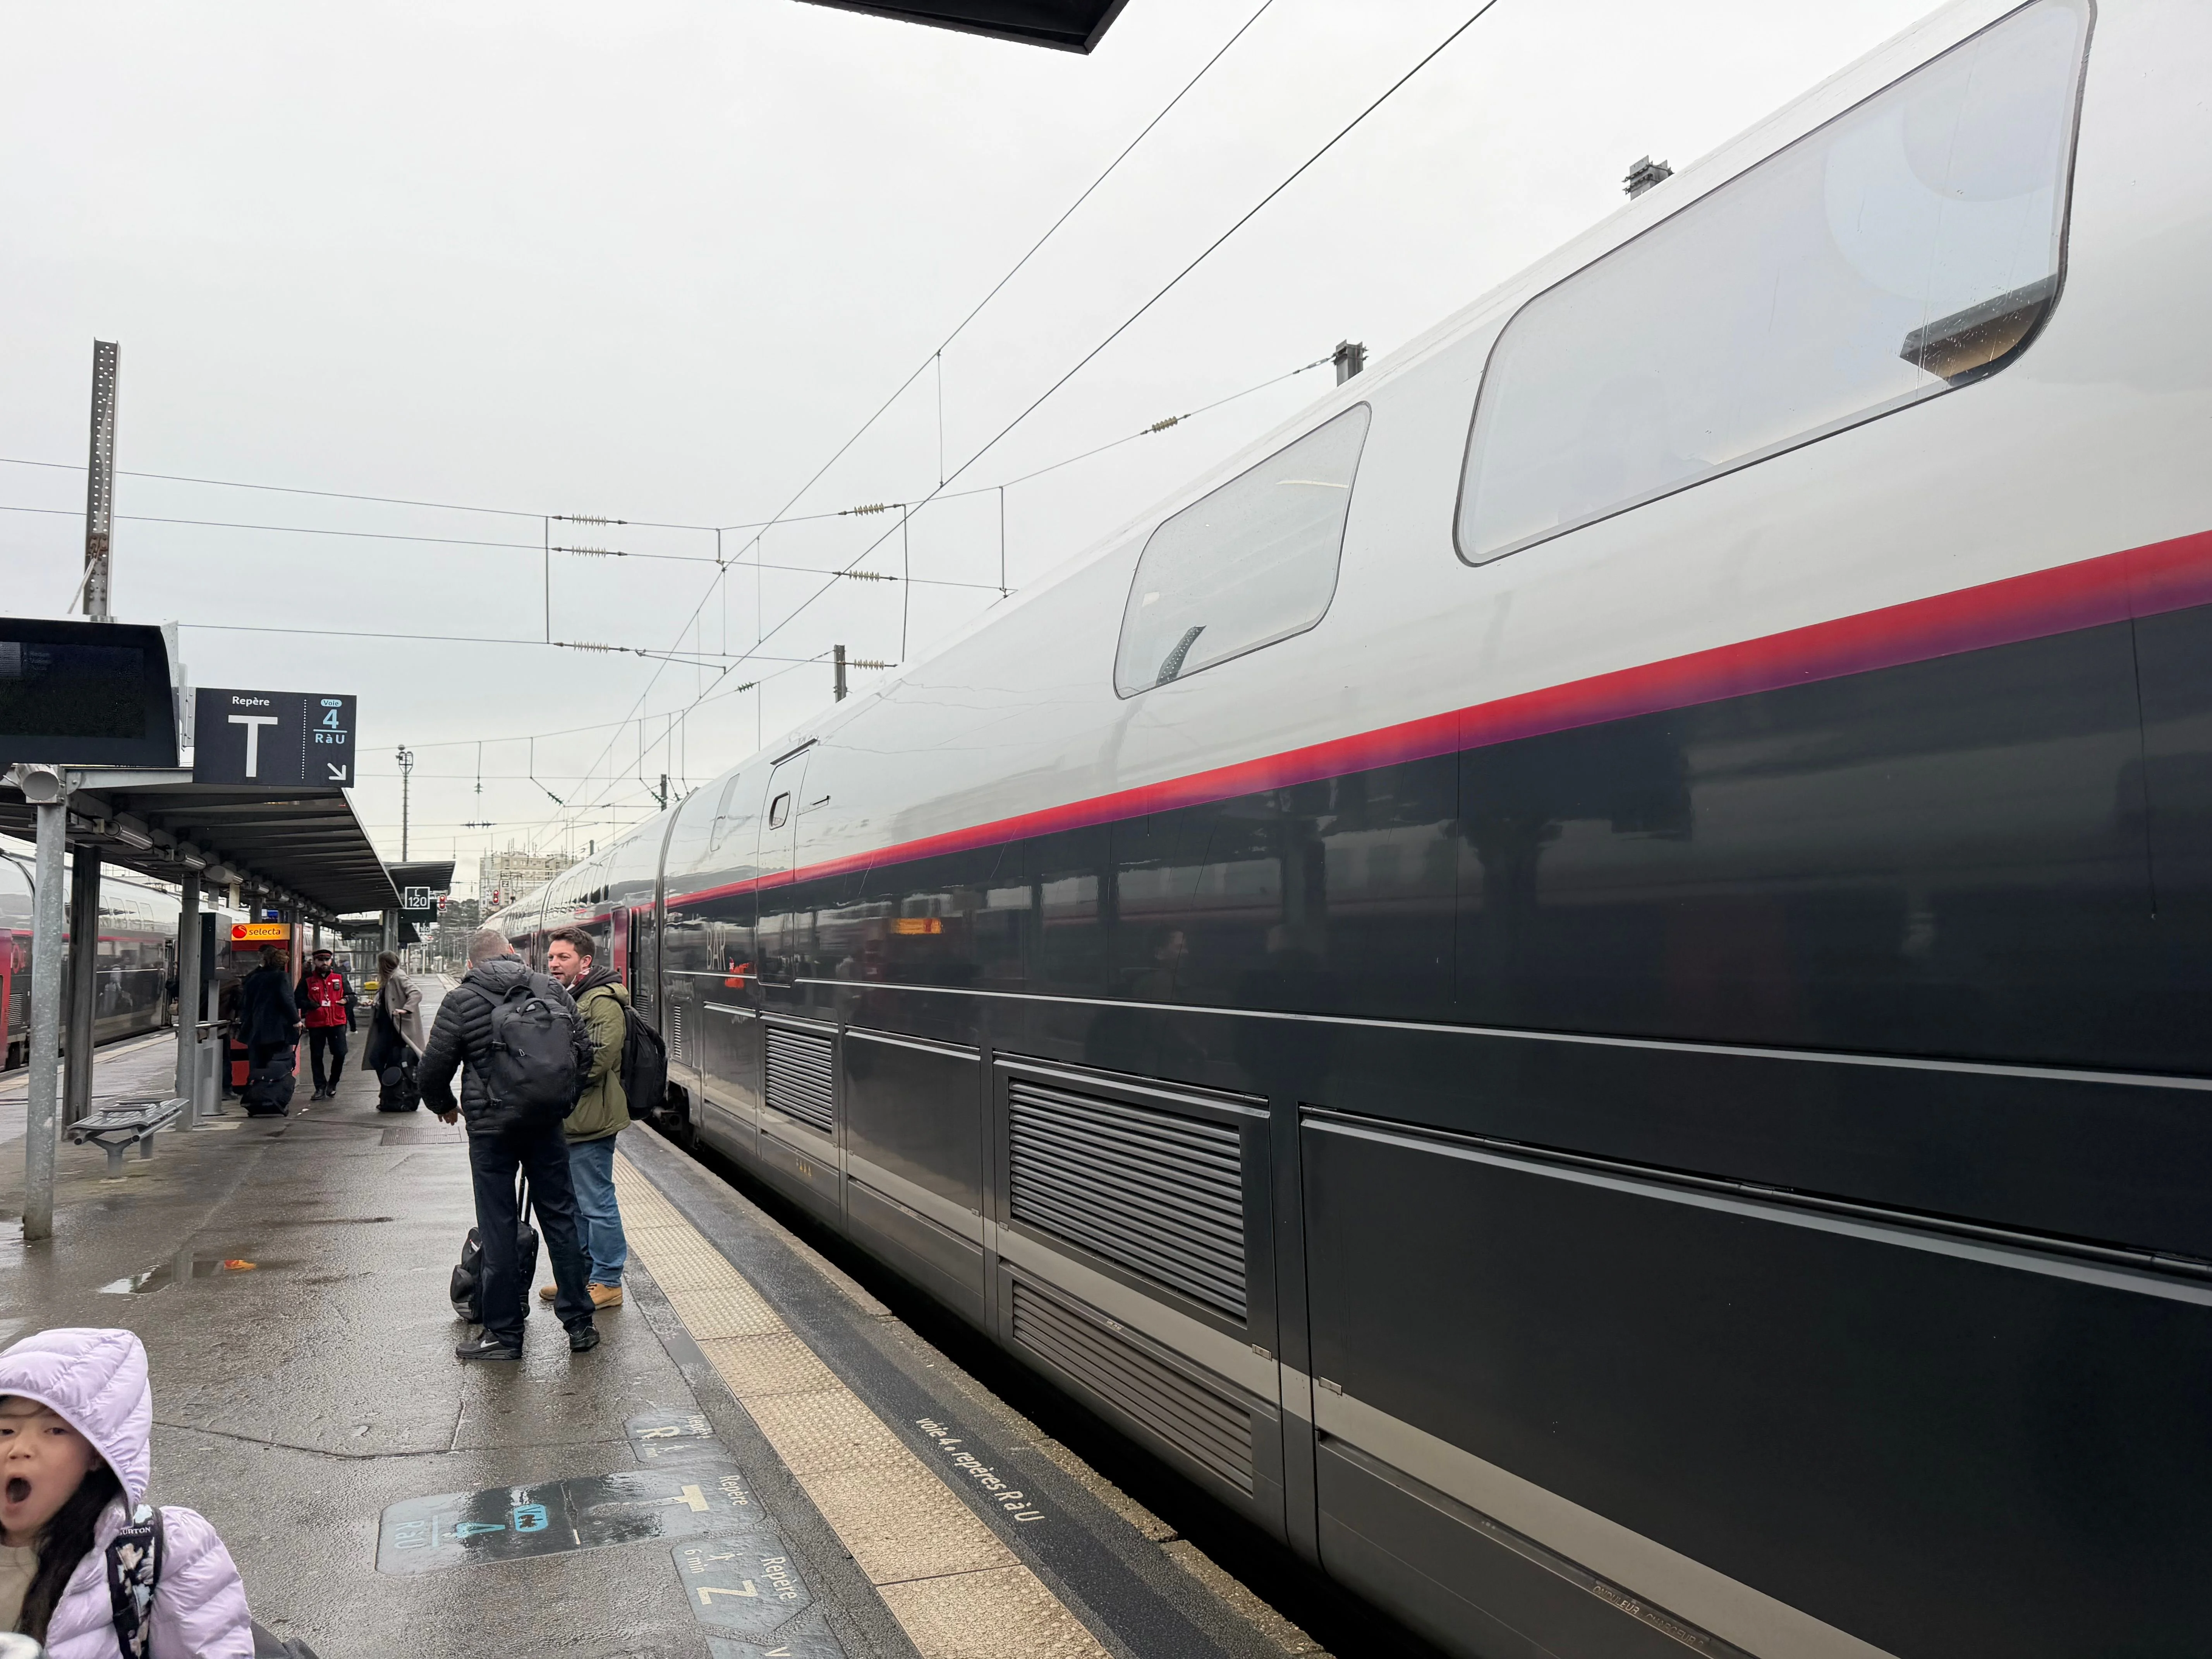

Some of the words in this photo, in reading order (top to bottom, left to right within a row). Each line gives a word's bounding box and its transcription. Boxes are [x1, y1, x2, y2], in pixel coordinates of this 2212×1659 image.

[232, 696, 270, 707] Repère
[323, 709, 339, 729] 4
[315, 733, 323, 743] R
[326, 734, 333, 744] à
[336, 735, 345, 744] U
[228, 715, 278, 777] T
[408, 896, 427, 907] 120
[707, 926, 726, 970] BAR
[636, 1426, 680, 1439] R
[685, 1415, 710, 1439] Repère
[916, 1418, 949, 1437] voie
[644, 1448, 661, 1458] min
[951, 1452, 1007, 1490] repères
[718, 1475, 749, 1506] Repère
[994, 1491, 1024, 1501] R
[1004, 1502, 1032, 1510] à
[1014, 1511, 1045, 1522] U
[120, 1527, 151, 1535] URTON
[396, 1520, 424, 1531] R
[394, 1539, 426, 1549] U
[686, 1556, 708, 1574] min
[761, 1556, 798, 1601] Repère
[696, 1580, 758, 1605] Z
